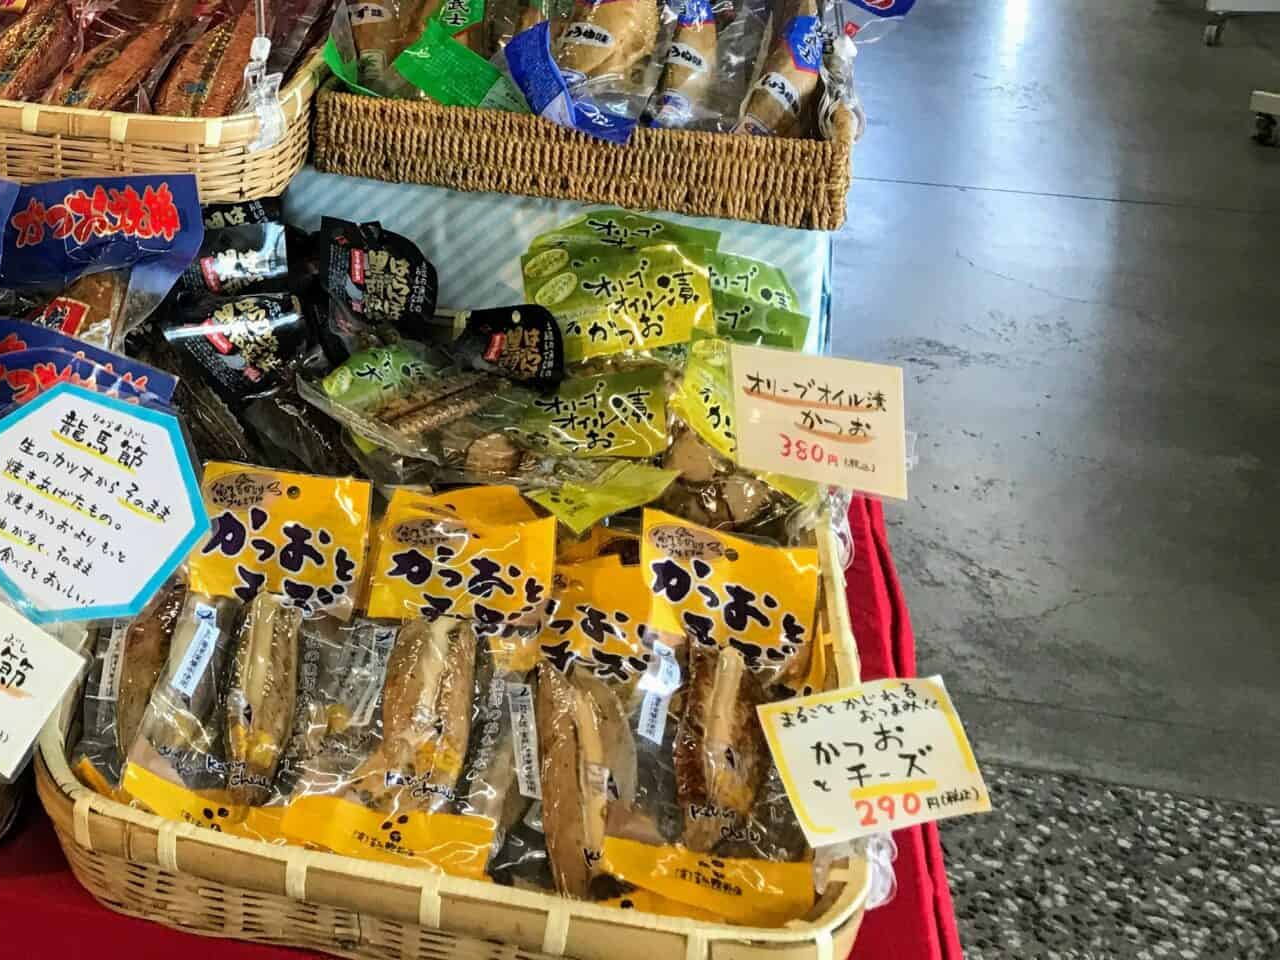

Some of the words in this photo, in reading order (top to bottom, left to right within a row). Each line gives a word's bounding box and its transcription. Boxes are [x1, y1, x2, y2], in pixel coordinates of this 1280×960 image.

[745, 369, 888, 413] オリーブオイル漬
[59, 409, 149, 469] 龍馬節
[801, 409, 873, 437] かつお
[201, 507, 357, 582] かつおと
[386, 545, 546, 604] かつおと
[650, 558, 806, 644] かつおと
[810, 722, 905, 766] かつお
[847, 744, 934, 788] チーズ
